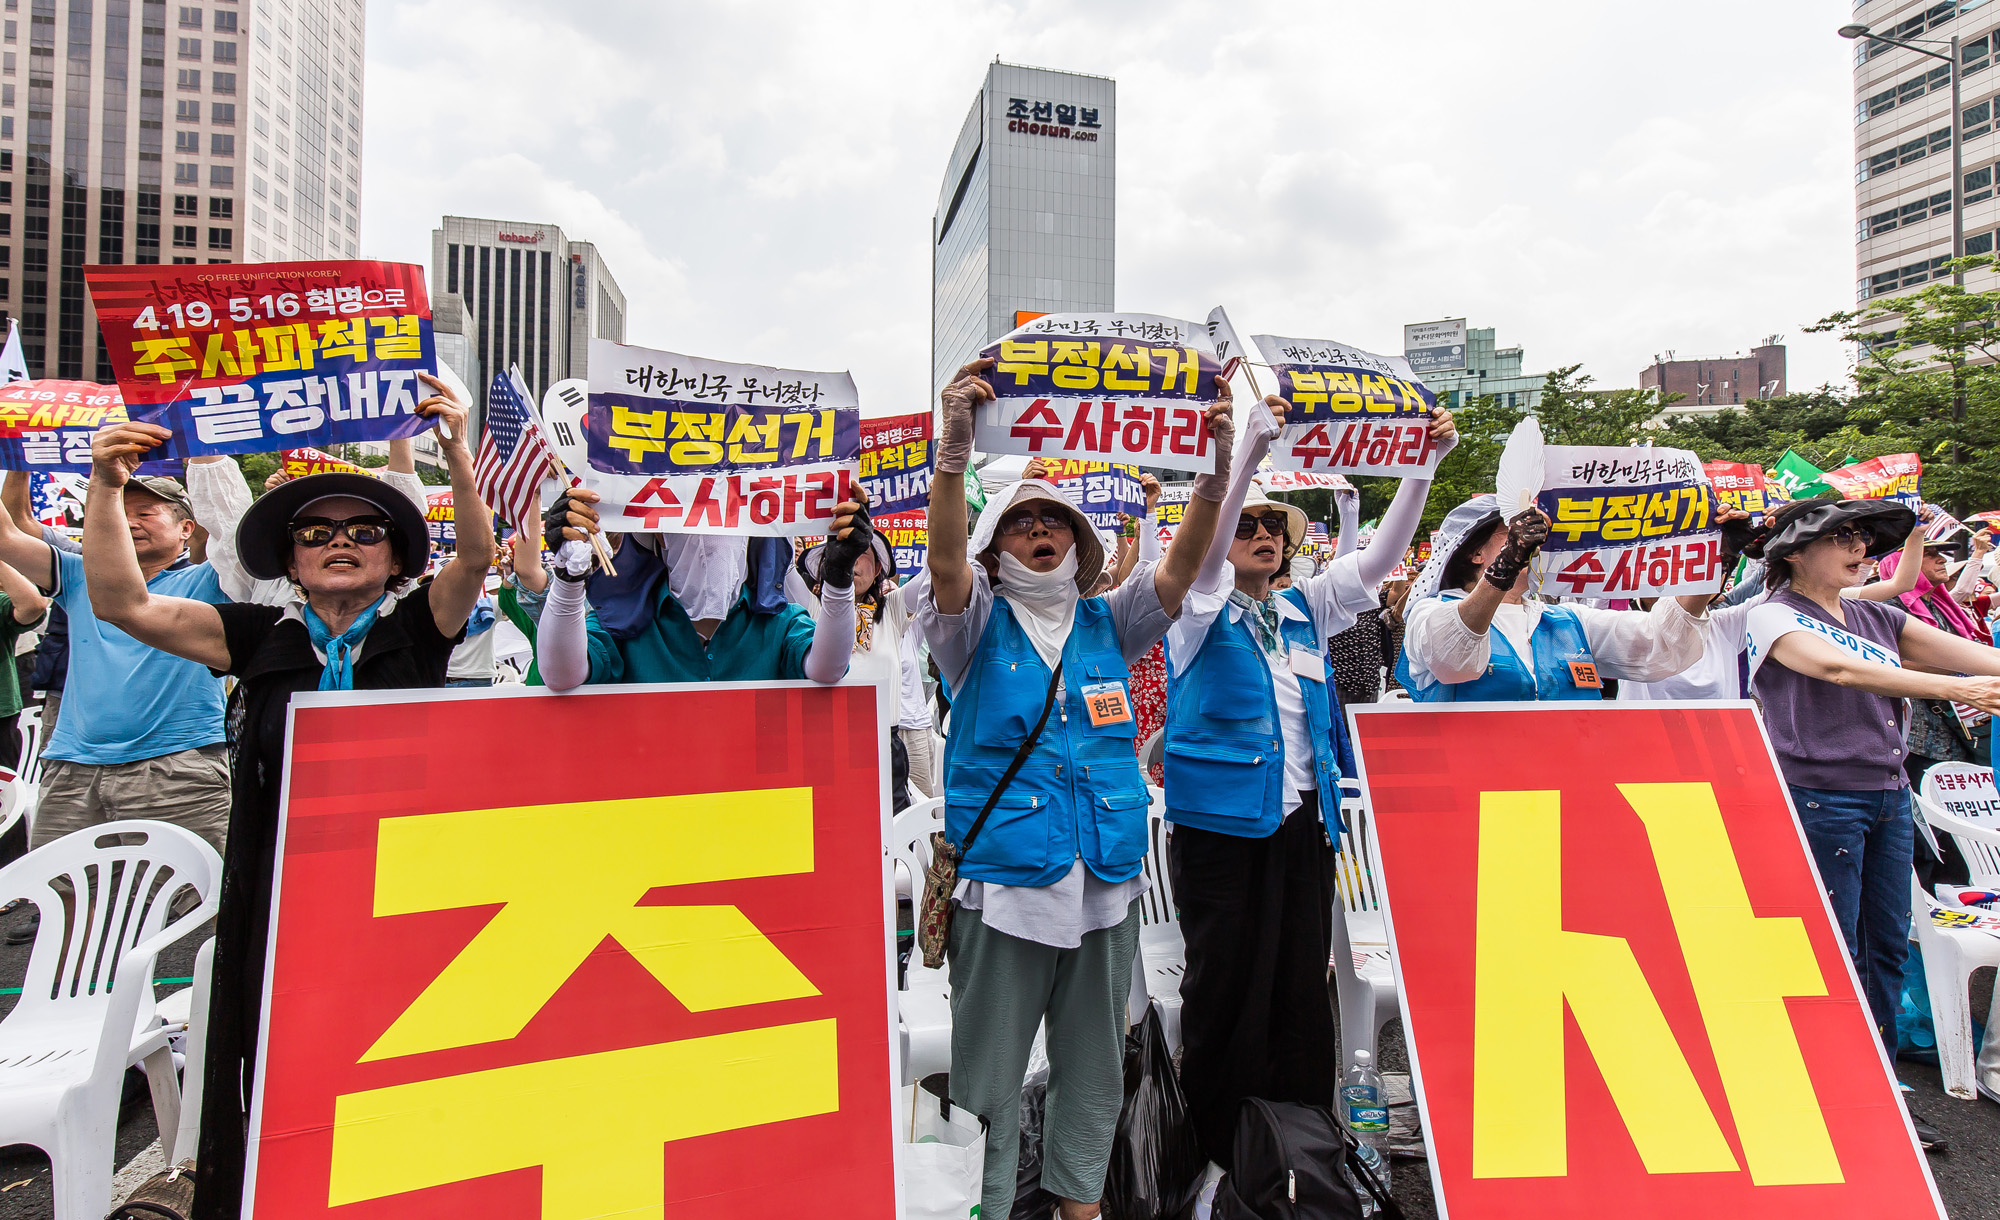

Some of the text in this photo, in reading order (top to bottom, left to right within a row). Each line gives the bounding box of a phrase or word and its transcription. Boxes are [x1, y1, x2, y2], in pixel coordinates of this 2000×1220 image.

[1006, 97, 1102, 128] 조선일보
[1008, 118, 1098, 142] chosun.com
[499, 231, 537, 244] kobaco
[197, 270, 342, 282] GO FREE UNIFICATION KOREA!
[132, 302, 219, 331] 4.19,
[229, 293, 300, 321] 5.16
[305, 286, 407, 316] 혁명으로
[131, 314, 422, 384] 주사파척결
[1283, 346, 1348, 366] 대한민국
[1409, 357, 1436, 365] TOEFL
[997, 339, 1199, 394] 부정선거
[7, 390, 56, 402] 4.19,
[63, 391, 111, 406] 5.16
[625, 365, 825, 404] 대한민국 무너졌다
[1288, 370, 1427, 414] 부정선거
[190, 368, 439, 444] 끝장내자
[608, 405, 836, 466] 부정선거
[876, 427, 922, 445] 혁명으로
[1010, 398, 1215, 457] 수사하라
[21, 431, 93, 464] 끝장
[289, 449, 321, 461] 4.19,
[860, 439, 927, 478] 파척결
[1291, 423, 1438, 468] 수사하라
[860, 467, 935, 508] 장내자
[1572, 459, 1651, 484] 대한민국
[1714, 475, 1755, 489] 혁명으로
[622, 469, 857, 529] 수사하라
[1057, 475, 1147, 506] 끝장내자
[1716, 489, 1765, 512] 척결
[893, 518, 913, 528] 5.16
[1155, 504, 1189, 524] 부정
[1551, 485, 1710, 542] 부정선거
[884, 530, 928, 546] 사파척
[1556, 540, 1722, 593] 수사하라
[1794, 612, 1900, 668] 안양대
[1574, 666, 1596, 682] 헌금
[1094, 697, 1123, 718] 헌금
[1473, 782, 1846, 1186] 사
[328, 786, 839, 1220] 주
